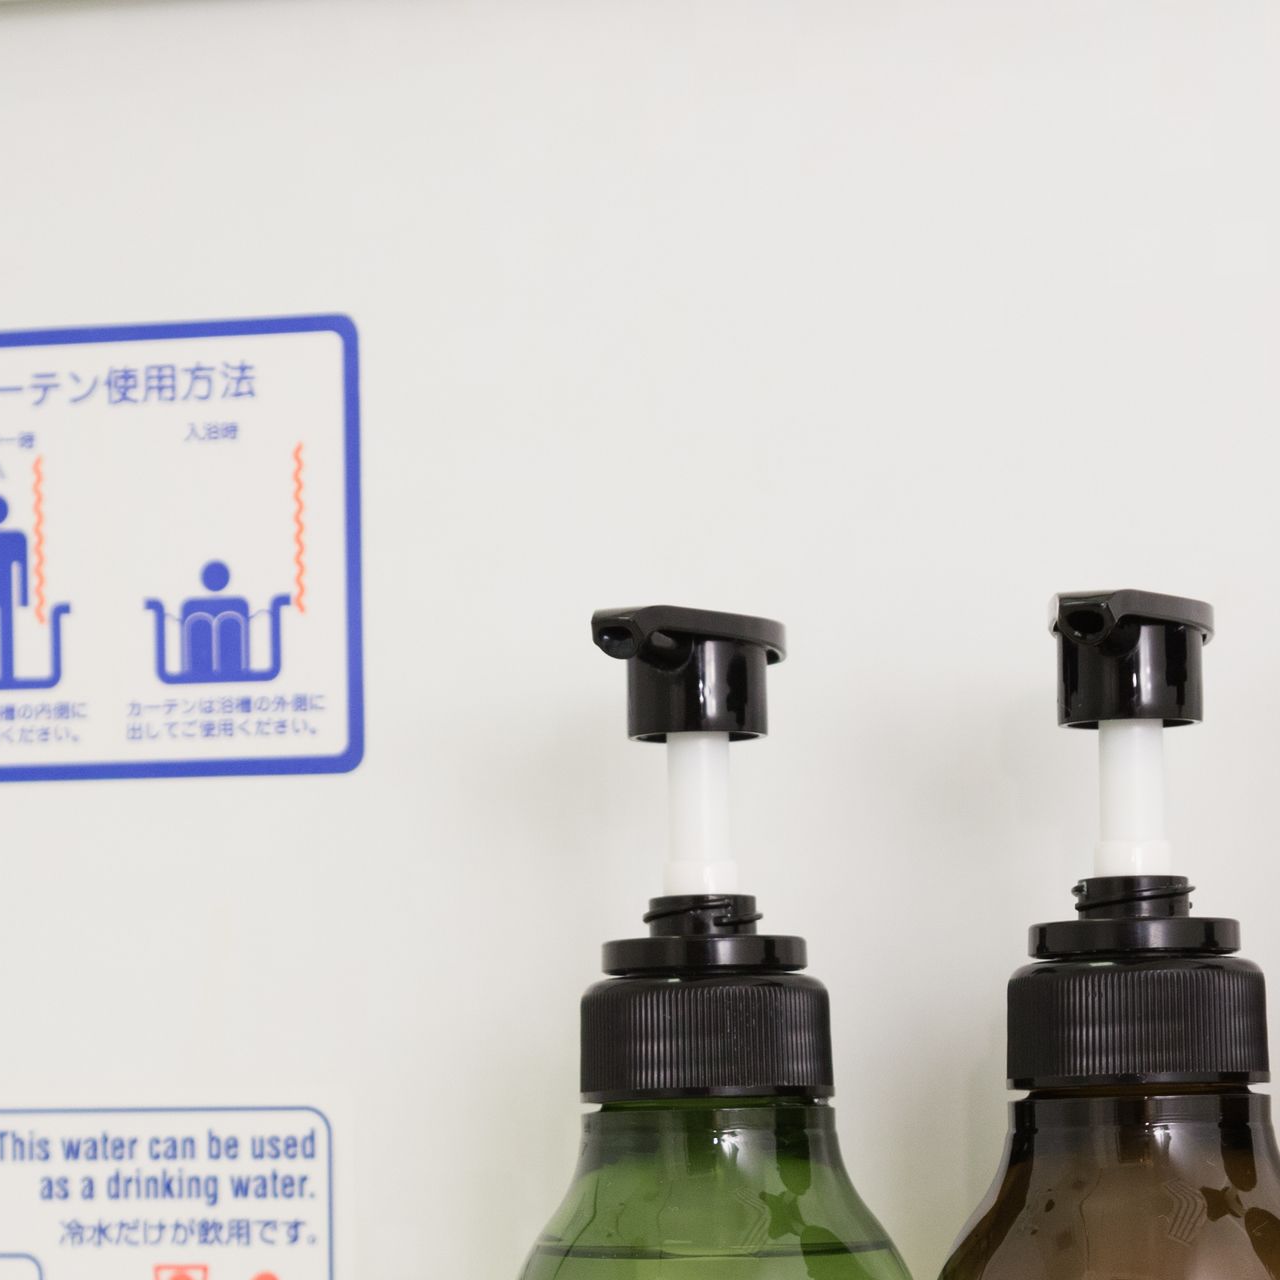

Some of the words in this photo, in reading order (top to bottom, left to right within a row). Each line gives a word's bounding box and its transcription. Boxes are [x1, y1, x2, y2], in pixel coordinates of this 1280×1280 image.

[184, 421, 239, 442] 入浴時
[126, 718, 319, 741] 出してご使用ください。
[63, 1134, 137, 1160] water
[150, 1137, 195, 1160] can
[208, 1131, 238, 1160] be
[251, 1128, 316, 1160] used
[40, 1178, 70, 1201] as
[82, 1177, 94, 1200] a
[108, 1171, 218, 1206] drinking
[231, 1170, 316, 1200] water.
[58, 1218, 317, 1247] 冷水だけが飲用です。
